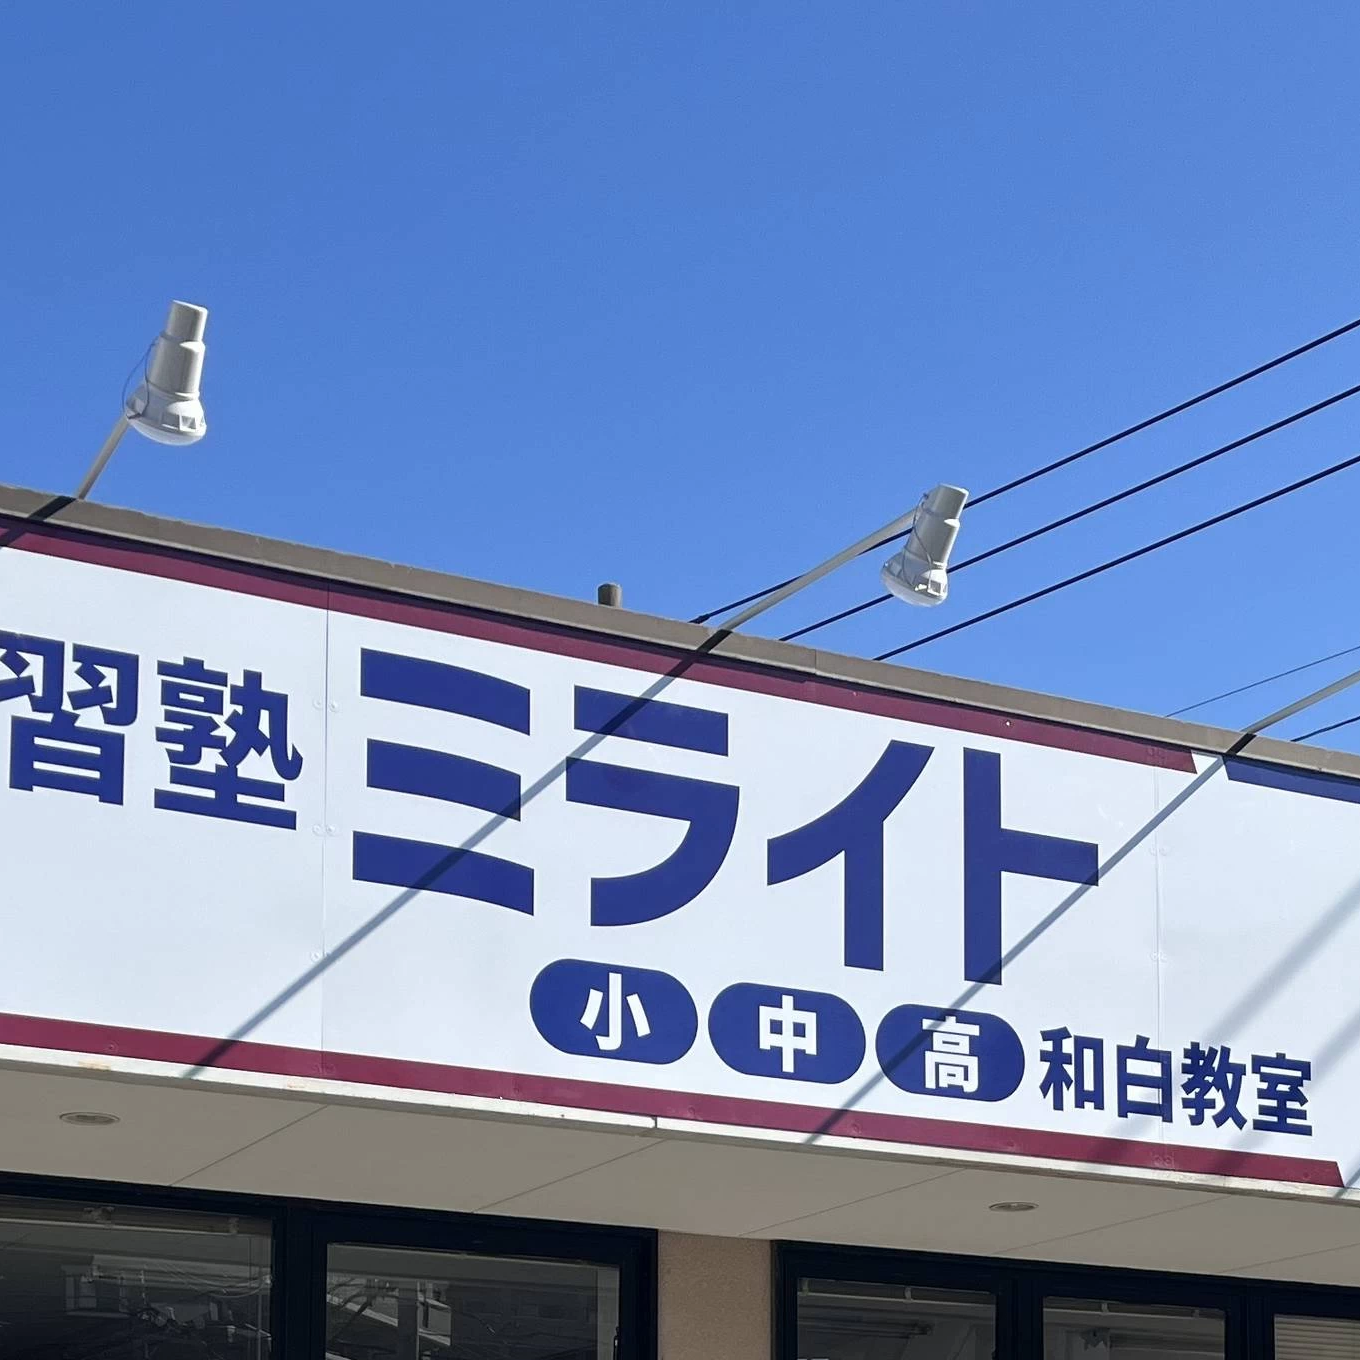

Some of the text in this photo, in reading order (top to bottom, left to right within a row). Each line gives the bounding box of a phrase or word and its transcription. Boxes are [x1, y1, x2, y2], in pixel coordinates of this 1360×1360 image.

[352, 647, 1099, 986] ミライト
[579, 972, 1314, 1137] 小 中 高 和白教室
